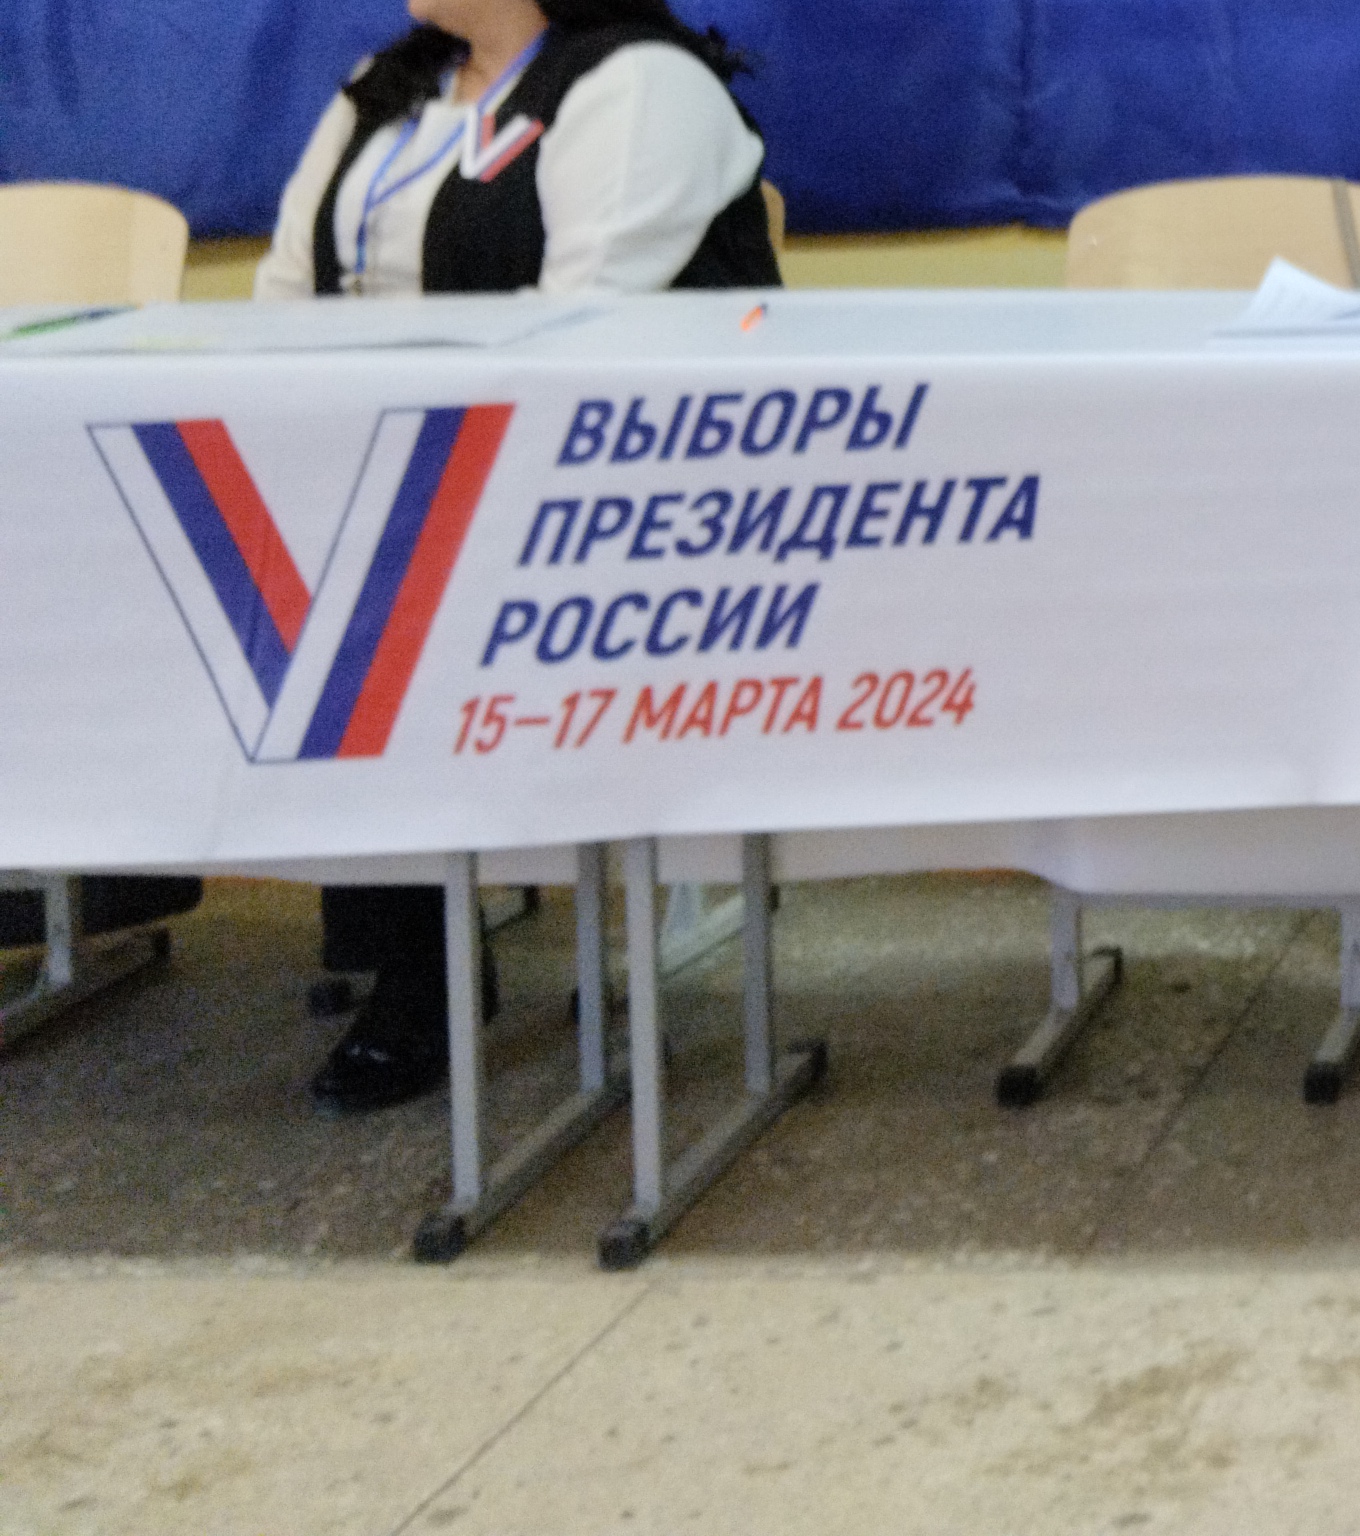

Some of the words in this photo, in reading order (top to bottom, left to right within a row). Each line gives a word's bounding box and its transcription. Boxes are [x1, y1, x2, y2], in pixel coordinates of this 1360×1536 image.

[557, 382, 930, 467] ВЫБОРЫ
[518, 474, 1041, 567] ПРЕЗИДЕНТА
[480, 582, 821, 668] РОССИИ
[622, 674, 824, 745] МАРТА
[835, 667, 976, 734] 2024
